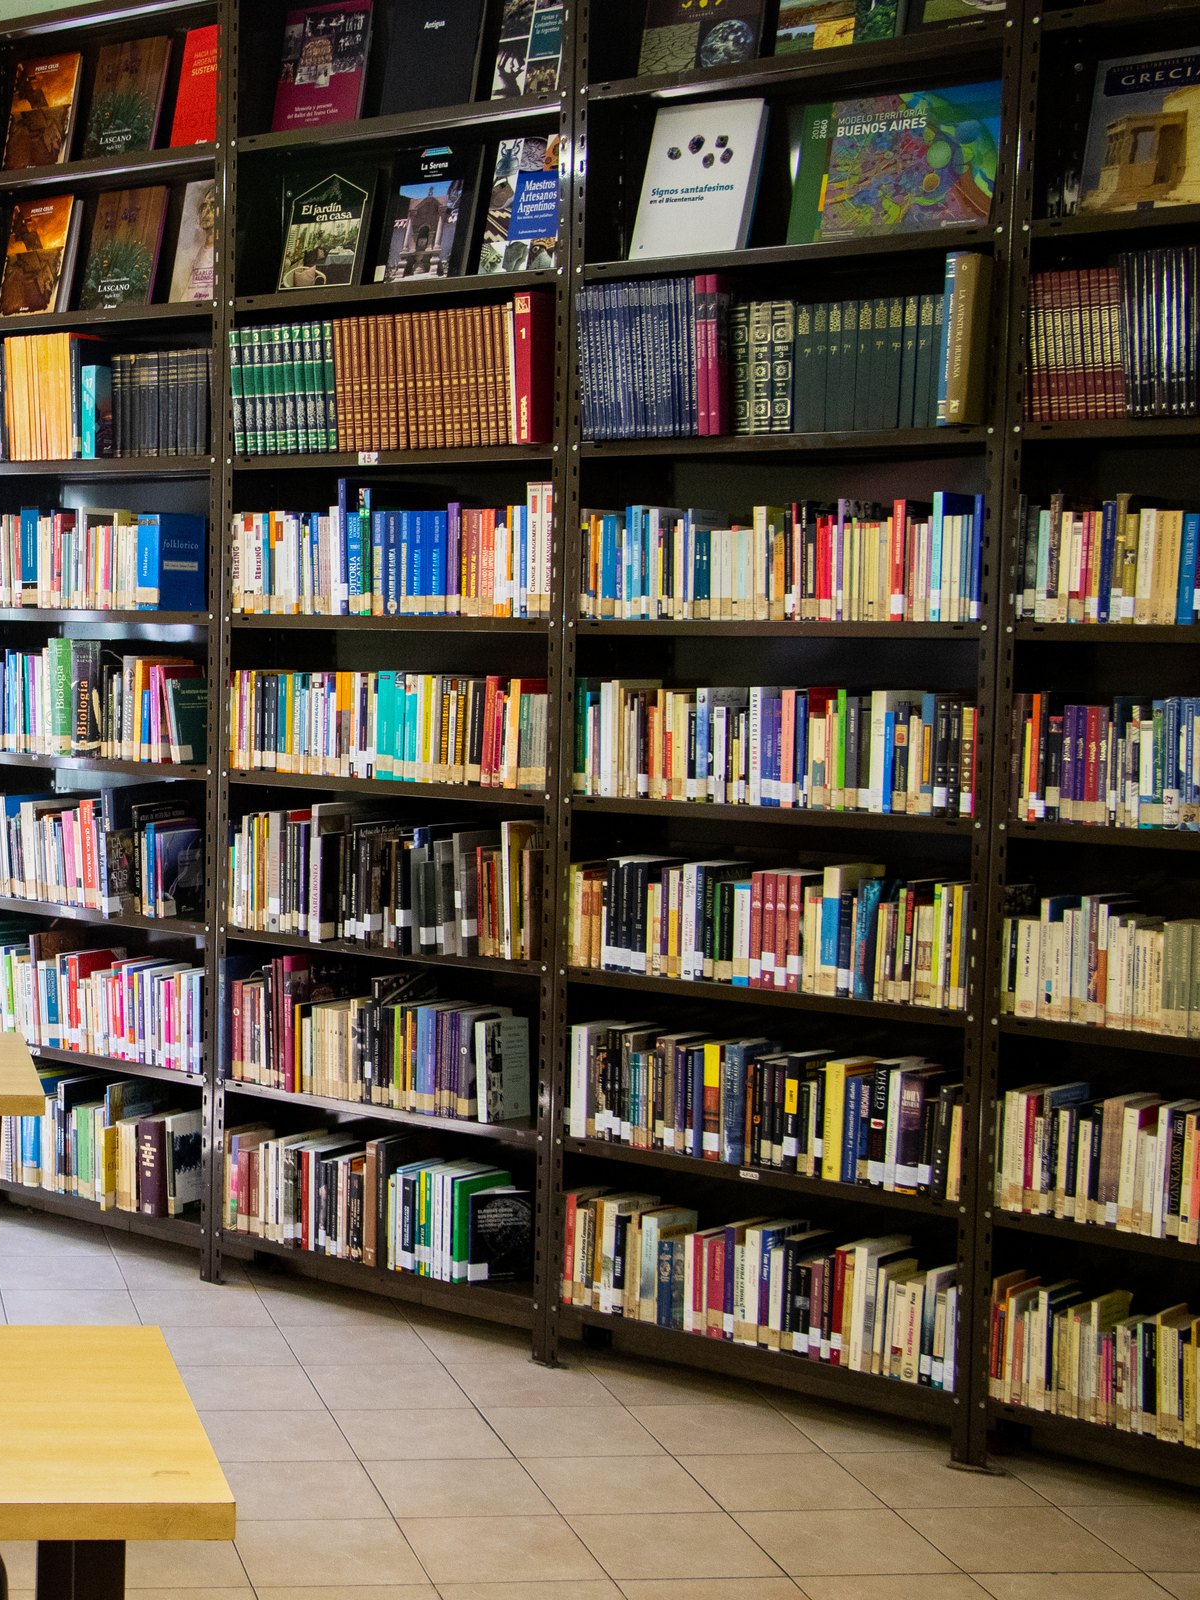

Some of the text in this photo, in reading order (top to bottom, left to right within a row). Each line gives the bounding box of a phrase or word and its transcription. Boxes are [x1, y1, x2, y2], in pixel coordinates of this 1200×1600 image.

[424, 20, 446, 30] Antigua
[534, 20, 556, 29] Costumbres
[542, 25, 560, 34] Argentina
[194, 50, 210, 59] HACIA
[35, 62, 60, 72] PEREZ CELIS
[294, 104, 310, 112] Memoria
[838, 108, 928, 125] MODELO TERRITORIAL
[811, 120, 819, 140] 2010
[820, 119, 828, 139] 2060
[836, 117, 927, 138] BUENOS AIRES
[100, 134, 132, 144] LASCANO
[421, 161, 448, 170] La Serena
[525, 180, 556, 191] Maestros
[652, 183, 734, 197] Signos santafesinos
[520, 190, 558, 201] Artesanos
[665, 196, 704, 204] Bicentenario
[302, 203, 342, 215] El jardín
[518, 201, 556, 213] Argentinos
[316, 211, 352, 222] en casa
[98, 284, 130, 292] LASCANO
[232, 334, 235, 343] 1
[254, 332, 259, 342] 3
[274, 331, 279, 340] 5
[283, 330, 289, 340] 6
[294, 330, 300, 339] 7
[304, 328, 309, 338] 8
[313, 328, 319, 337] 9
[520, 328, 526, 340] 1
[953, 289, 966, 378] LA AVENTURA HUMANA
[1074, 334, 1082, 364] NATURALES
[1083, 334, 1091, 363] NATURALES
[1103, 333, 1111, 363] NATURALES
[1113, 332, 1121, 362] NATURALES
[520, 395, 528, 439] EUROPA
[163, 538, 198, 550] folklórico
[1185, 521, 1195, 566] WILBUR SMITH
[254, 546, 262, 580] RESIZING
[349, 556, 357, 595] UDITORIA
[55, 665, 66, 709] Biología
[77, 680, 89, 735] Biología
[1063, 736, 1071, 761] NARNIA
[1182, 814, 1196, 822] 28
[111, 838, 121, 848] CA
[112, 848, 122, 859] ME
[876, 1069, 887, 1110] GEISHA
[902, 1089, 920, 1101] JOHN
[860, 1084, 870, 1118] NEUROMANTE
[1168, 1141, 1182, 1212] UTANKAMON
